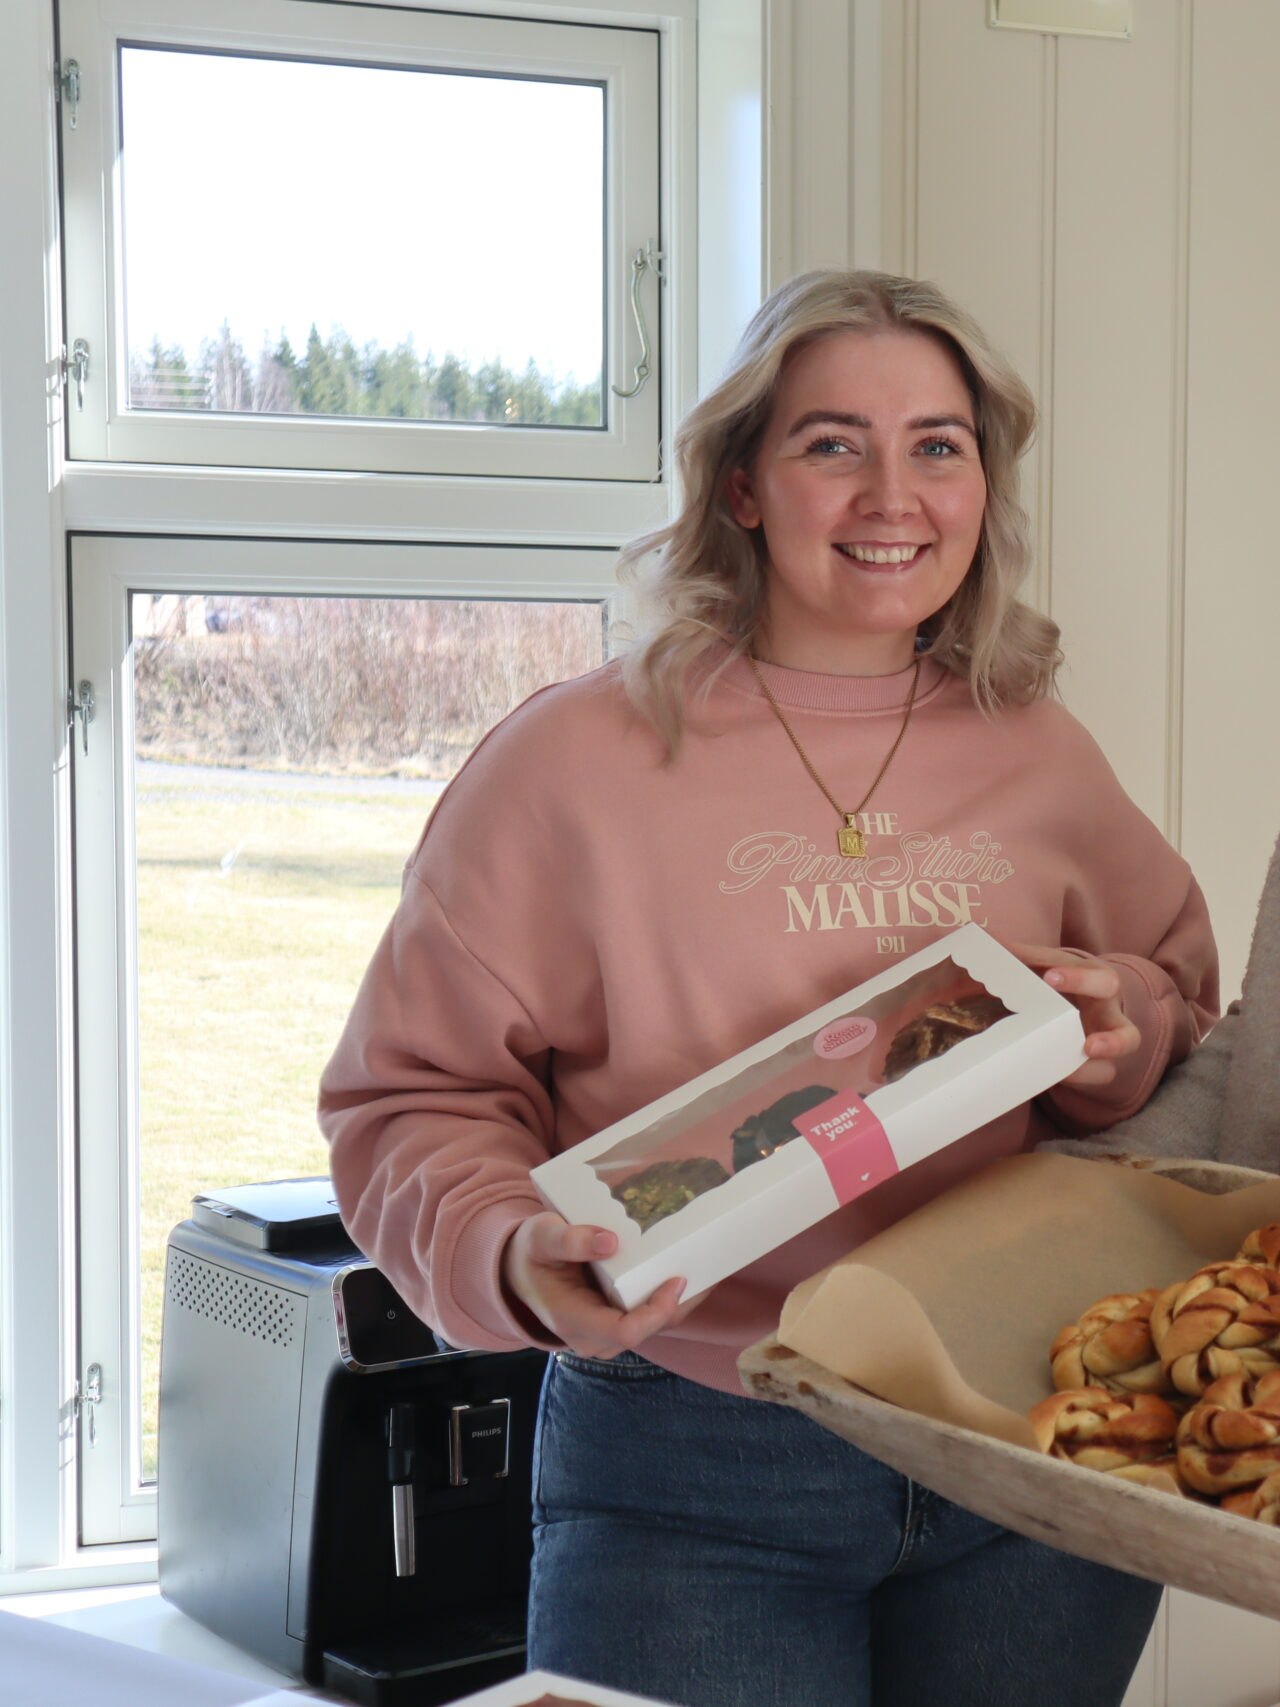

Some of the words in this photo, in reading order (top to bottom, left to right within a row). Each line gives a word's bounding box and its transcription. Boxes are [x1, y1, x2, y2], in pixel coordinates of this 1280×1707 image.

[861, 831, 1015, 892] Studio
[779, 880, 988, 933] MATISSE
[876, 936, 906, 954] 1911
[810, 1106, 860, 1136] Thank
[472, 1427, 501, 1438] PHILIPS
